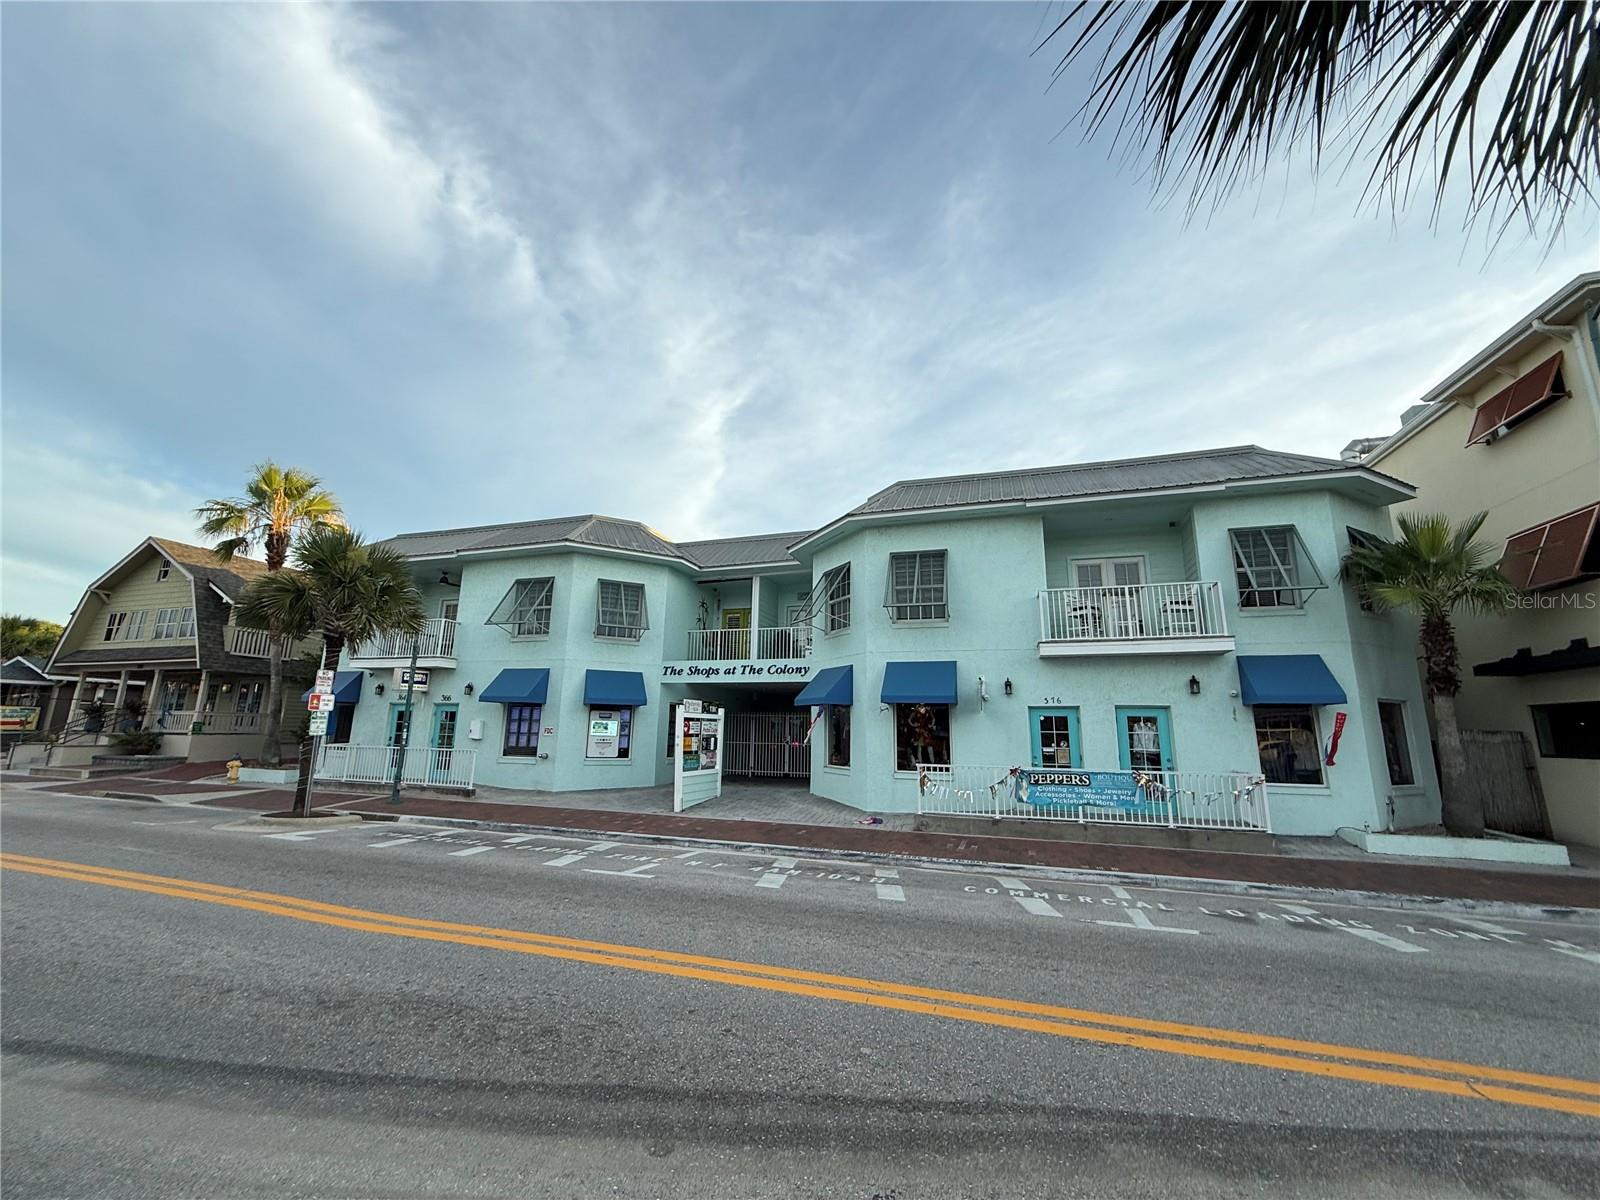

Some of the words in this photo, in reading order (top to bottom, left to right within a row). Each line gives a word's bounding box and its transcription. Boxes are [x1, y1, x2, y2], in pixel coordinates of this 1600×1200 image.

[662, 666, 683, 676] The
[687, 665, 720, 678] Shops
[724, 666, 736, 675] at
[740, 665, 763, 675] The
[767, 664, 810, 677] Colony
[441, 694, 452, 702] 366
[1097, 774, 1134, 782] BOUTIQU
[963, 885, 1175, 911] COMMERCIAL
[1199, 906, 1374, 929] LOADING
